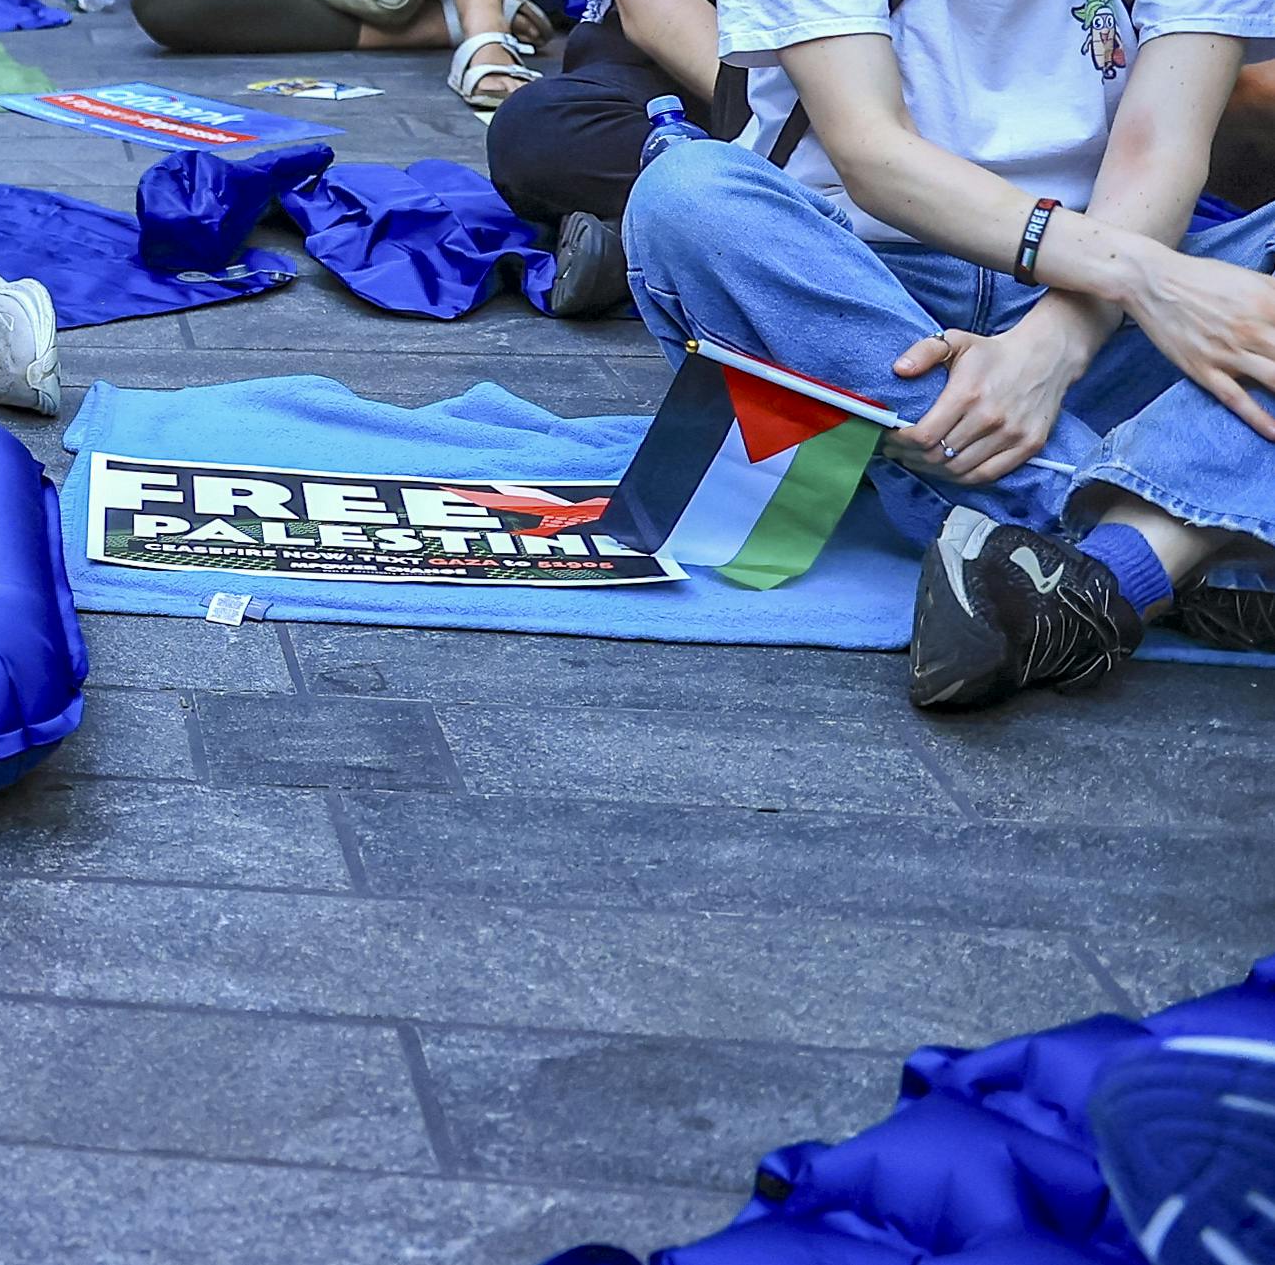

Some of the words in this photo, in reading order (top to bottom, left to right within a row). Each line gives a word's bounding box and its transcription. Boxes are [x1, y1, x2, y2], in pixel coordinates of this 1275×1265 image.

[1024, 208, 1050, 243] FREE
[104, 469, 502, 529] FREE
[144, 543, 278, 558] CEASEFIRE
[283, 550, 354, 562] NOW:
[356, 553, 424, 566] TEXT
[427, 556, 500, 567] GAZA
[502, 558, 532, 568] to
